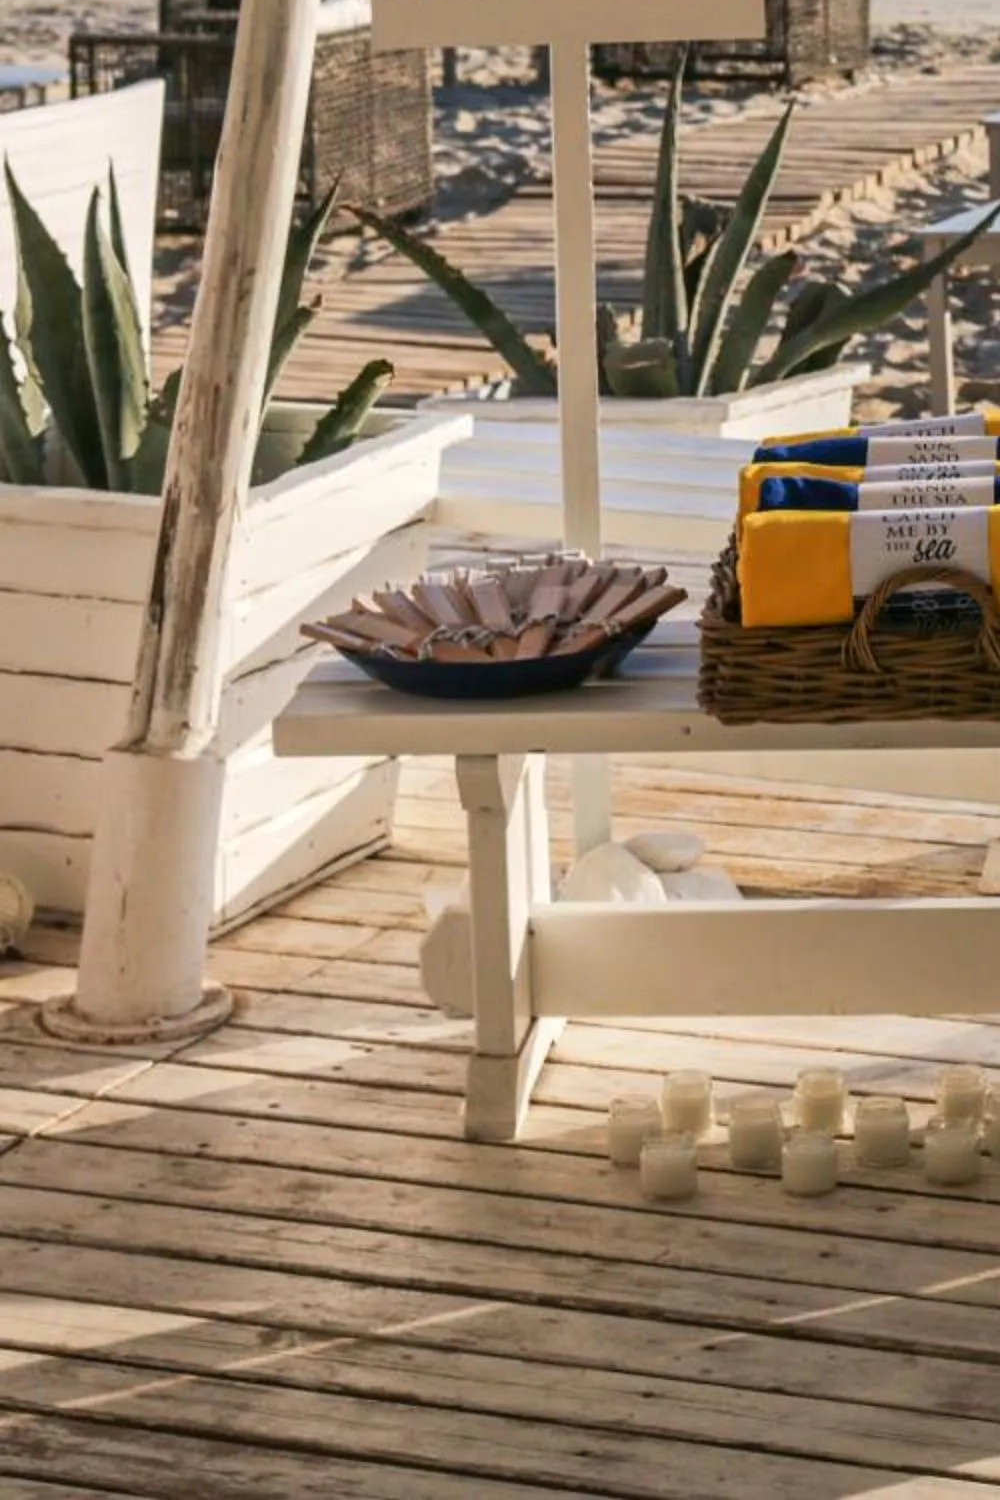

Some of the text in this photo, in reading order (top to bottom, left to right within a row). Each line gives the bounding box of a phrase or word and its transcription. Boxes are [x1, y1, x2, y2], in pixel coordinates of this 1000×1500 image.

[886, 523, 948, 538] ME BY
[913, 538, 956, 563] sea
